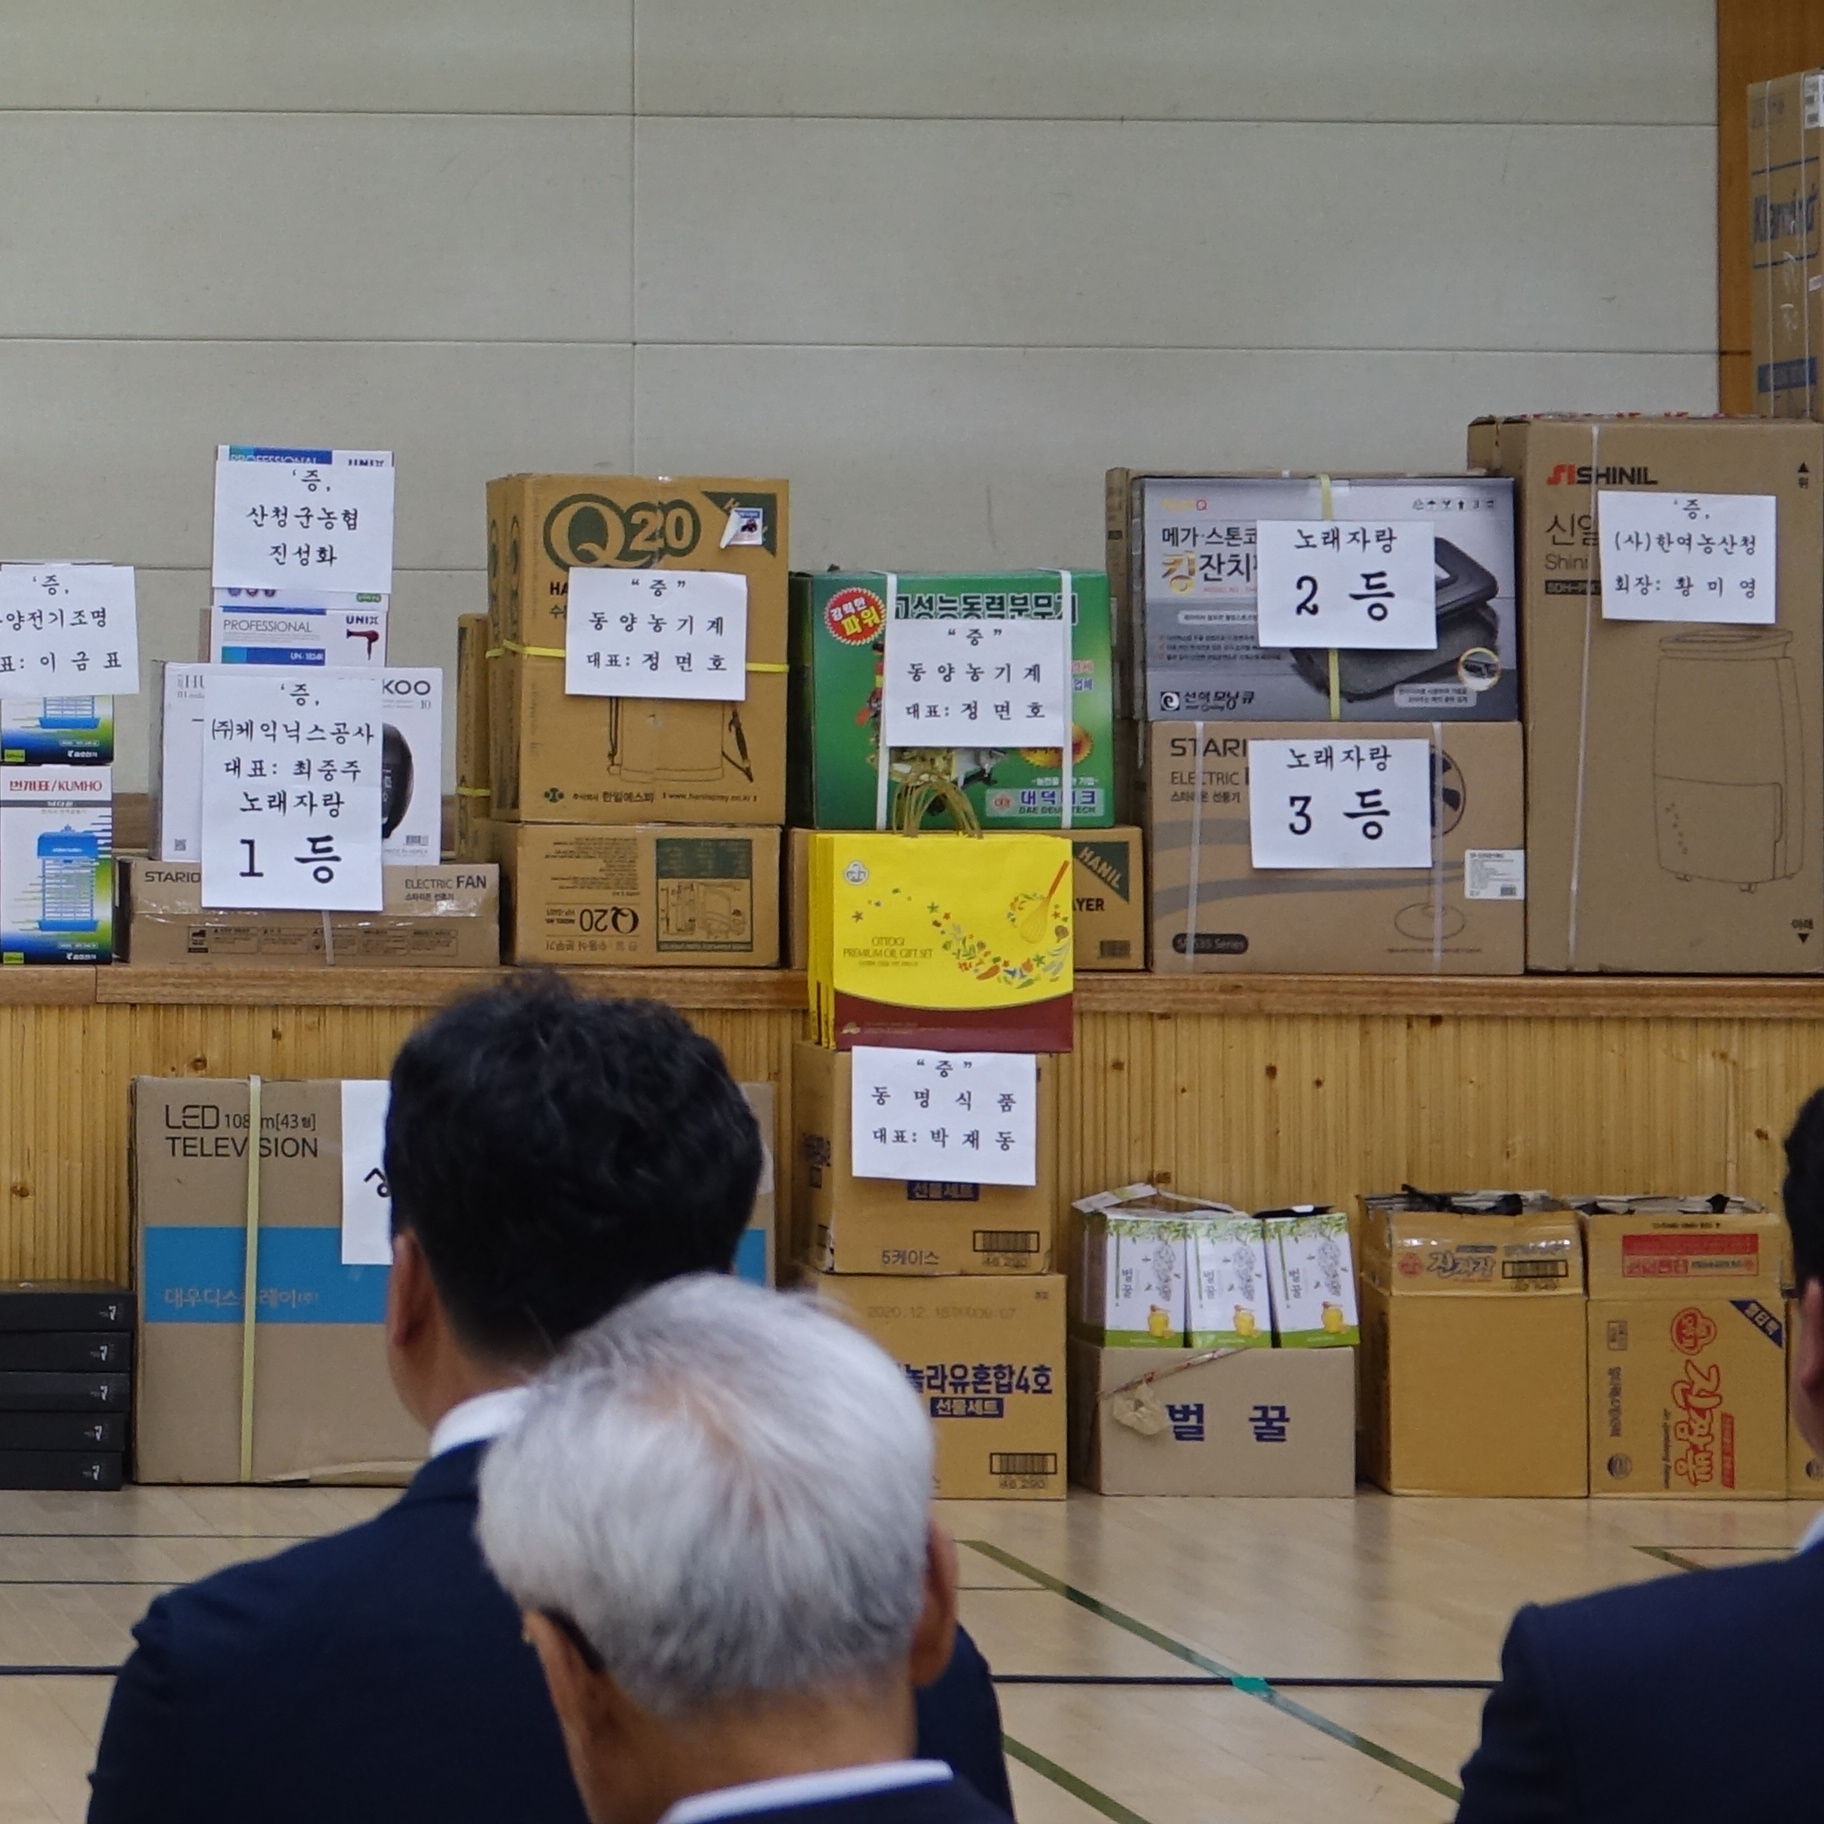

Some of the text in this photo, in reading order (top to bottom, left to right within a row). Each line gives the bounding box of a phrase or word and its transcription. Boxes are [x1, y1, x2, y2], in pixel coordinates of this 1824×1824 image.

[247, 504, 359, 531] 산청군농협
[543, 493, 702, 574] Q20
[1293, 527, 1398, 554] 노래자랑
[1614, 530, 1757, 555] (사)한여농산청
[269, 542, 338, 567] 진성화
[1544, 553, 1590, 571] Shini
[1614, 574, 1662, 596] 회장:
[223, 615, 380, 634] PROFESSIONAL UNIX
[586, 654, 631, 670] 대표:
[382, 679, 432, 696] KOO
[905, 706, 951, 720] 대표:
[1170, 737, 1248, 758] STARI
[224, 758, 279, 779] 대표:
[1286, 746, 1393, 772] 노래자랑
[239, 790, 346, 819] 노래자랑
[1020, 790, 1096, 806] 대덕크
[144, 870, 201, 883] STARIO
[1078, 846, 1122, 889] HANIL
[404, 875, 487, 890] ELECTRIC FAN
[1072, 897, 1105, 912] AYER
[579, 906, 640, 935] Q20
[164, 1104, 221, 1130] LED
[872, 1127, 918, 1145] 대표:
[164, 1136, 319, 1159] TELEVSION
[163, 1287, 319, 1310] 대우디스레이(주)
[904, 1363, 1054, 1396] 놀라유혼합4호
